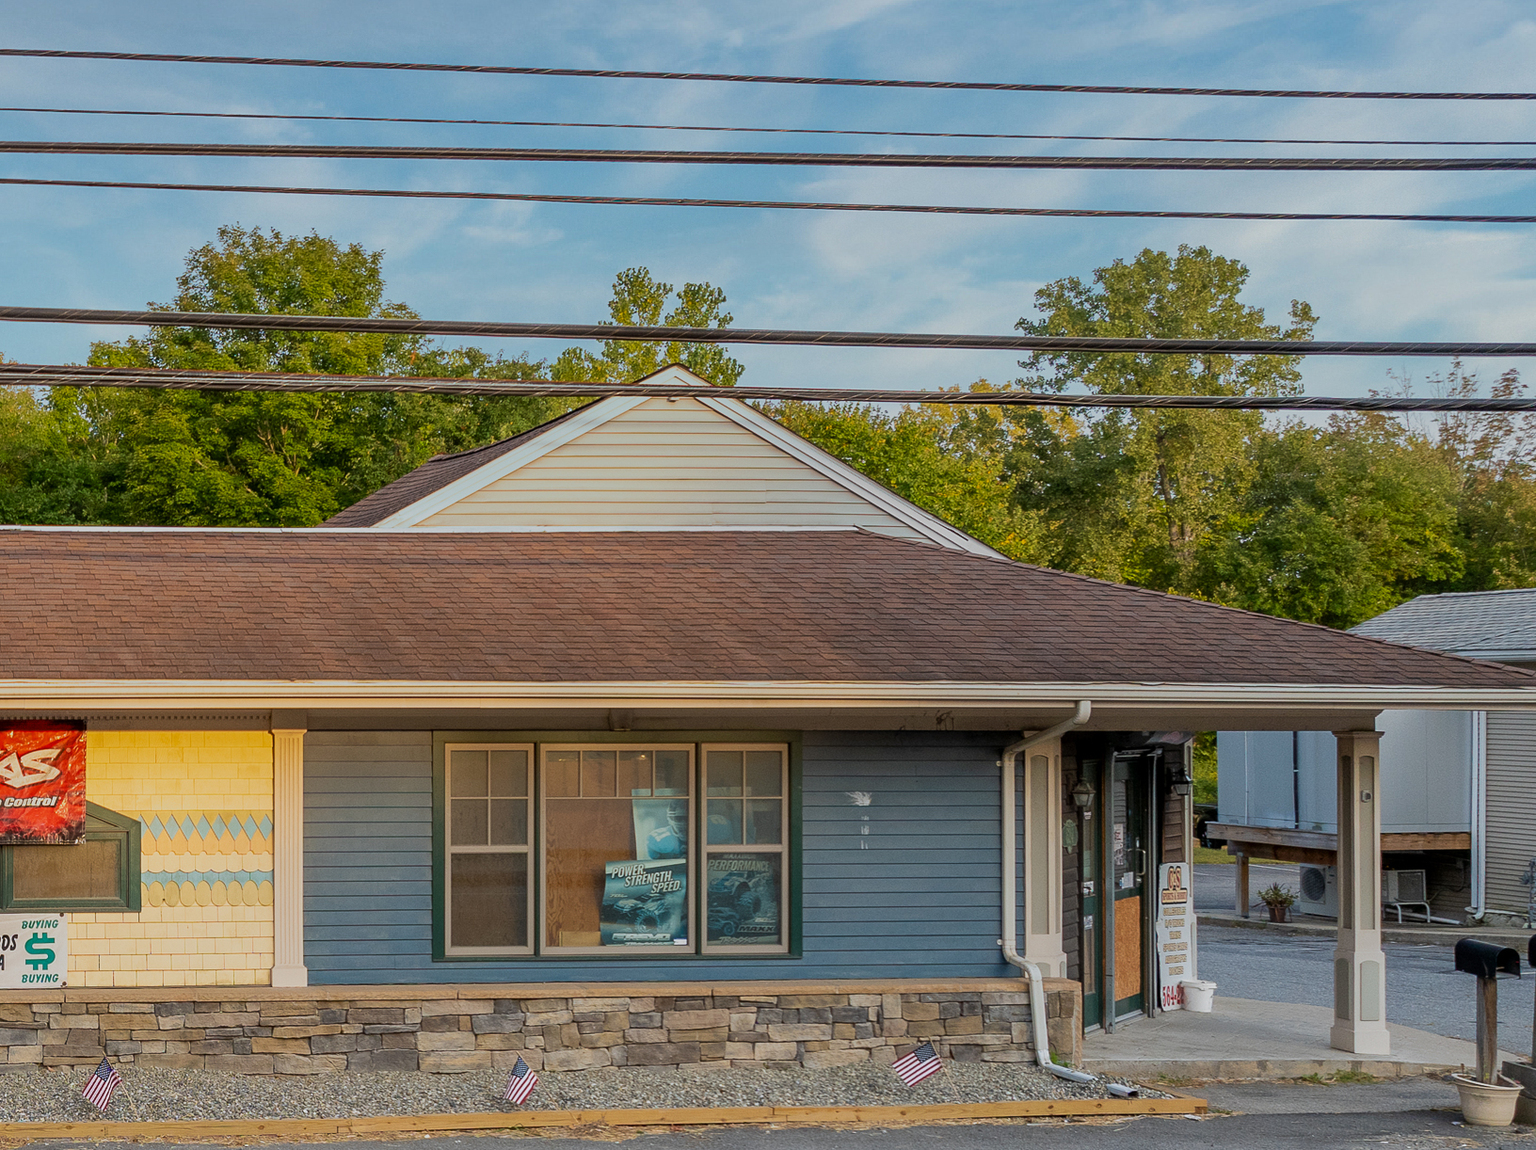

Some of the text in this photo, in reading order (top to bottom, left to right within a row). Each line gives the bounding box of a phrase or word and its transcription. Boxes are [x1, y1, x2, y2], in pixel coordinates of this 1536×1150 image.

[4, 796, 58, 807] Control
[611, 863, 646, 879] POWER.
[707, 860, 770, 872] PERFORMANCE
[624, 870, 674, 887] STRENGTH.
[651, 880, 682, 894] SPEED.
[21, 919, 59, 929] BUYING
[21, 974, 59, 984] BUYING
